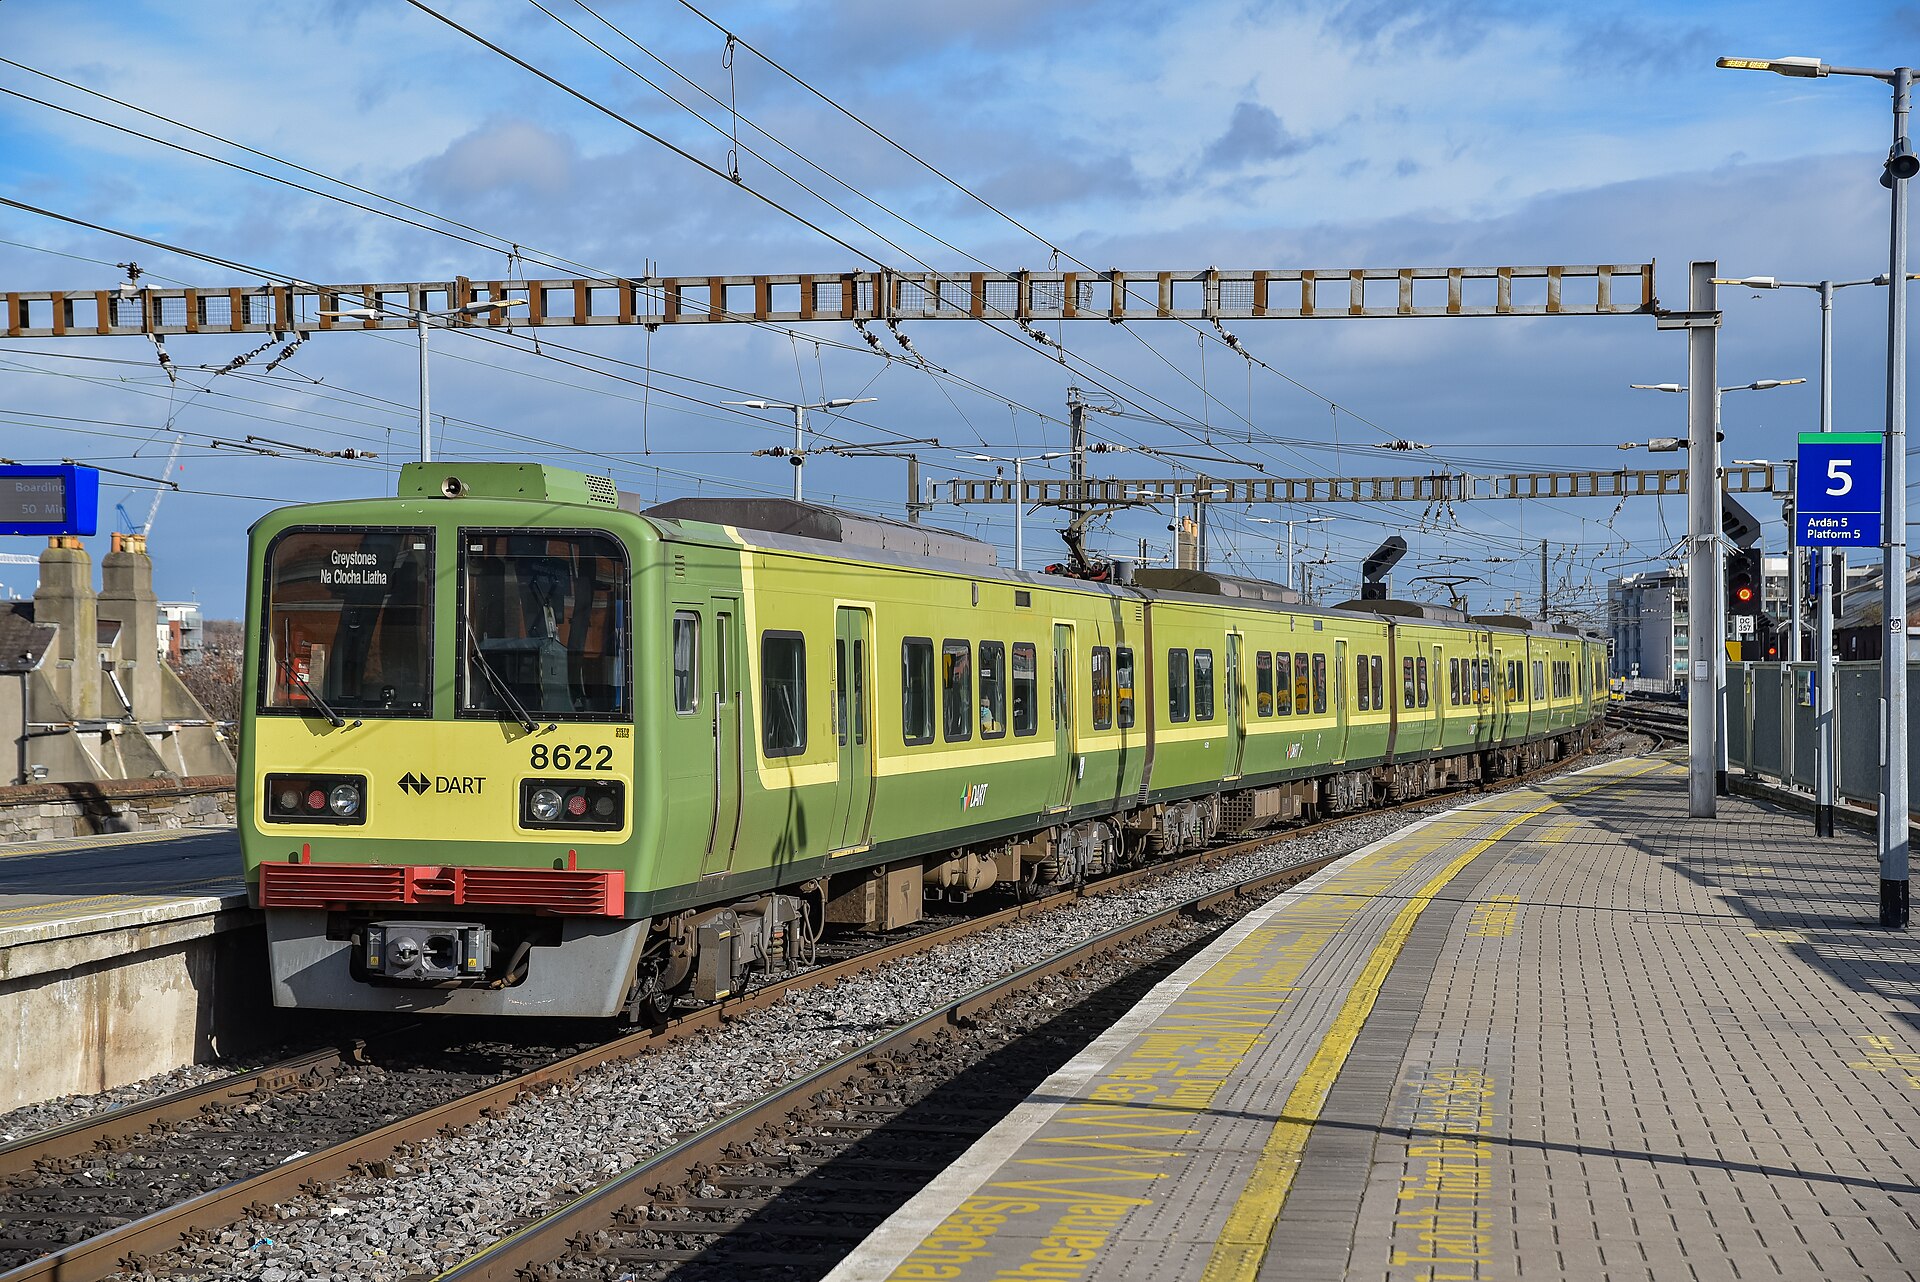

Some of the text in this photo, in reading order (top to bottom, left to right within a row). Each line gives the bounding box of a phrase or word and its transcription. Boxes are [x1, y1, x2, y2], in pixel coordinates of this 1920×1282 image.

[1826, 460, 1852, 496] 5
[15, 482, 65, 494] Boarding
[22, 504, 66, 514] 50 Min
[1808, 518, 1848, 527] Ardán 5
[1807, 529, 1861, 539] Platform 5
[331, 549, 377, 568] Greystones
[320, 569, 387, 585] Na Clocha Liatha
[530, 743, 613, 771] 8622
[435, 776, 486, 794] DART
[970, 783, 988, 807] DART
[885, 1200, 1041, 1282] Seacha
[989, 1203, 1131, 1282] hearna
